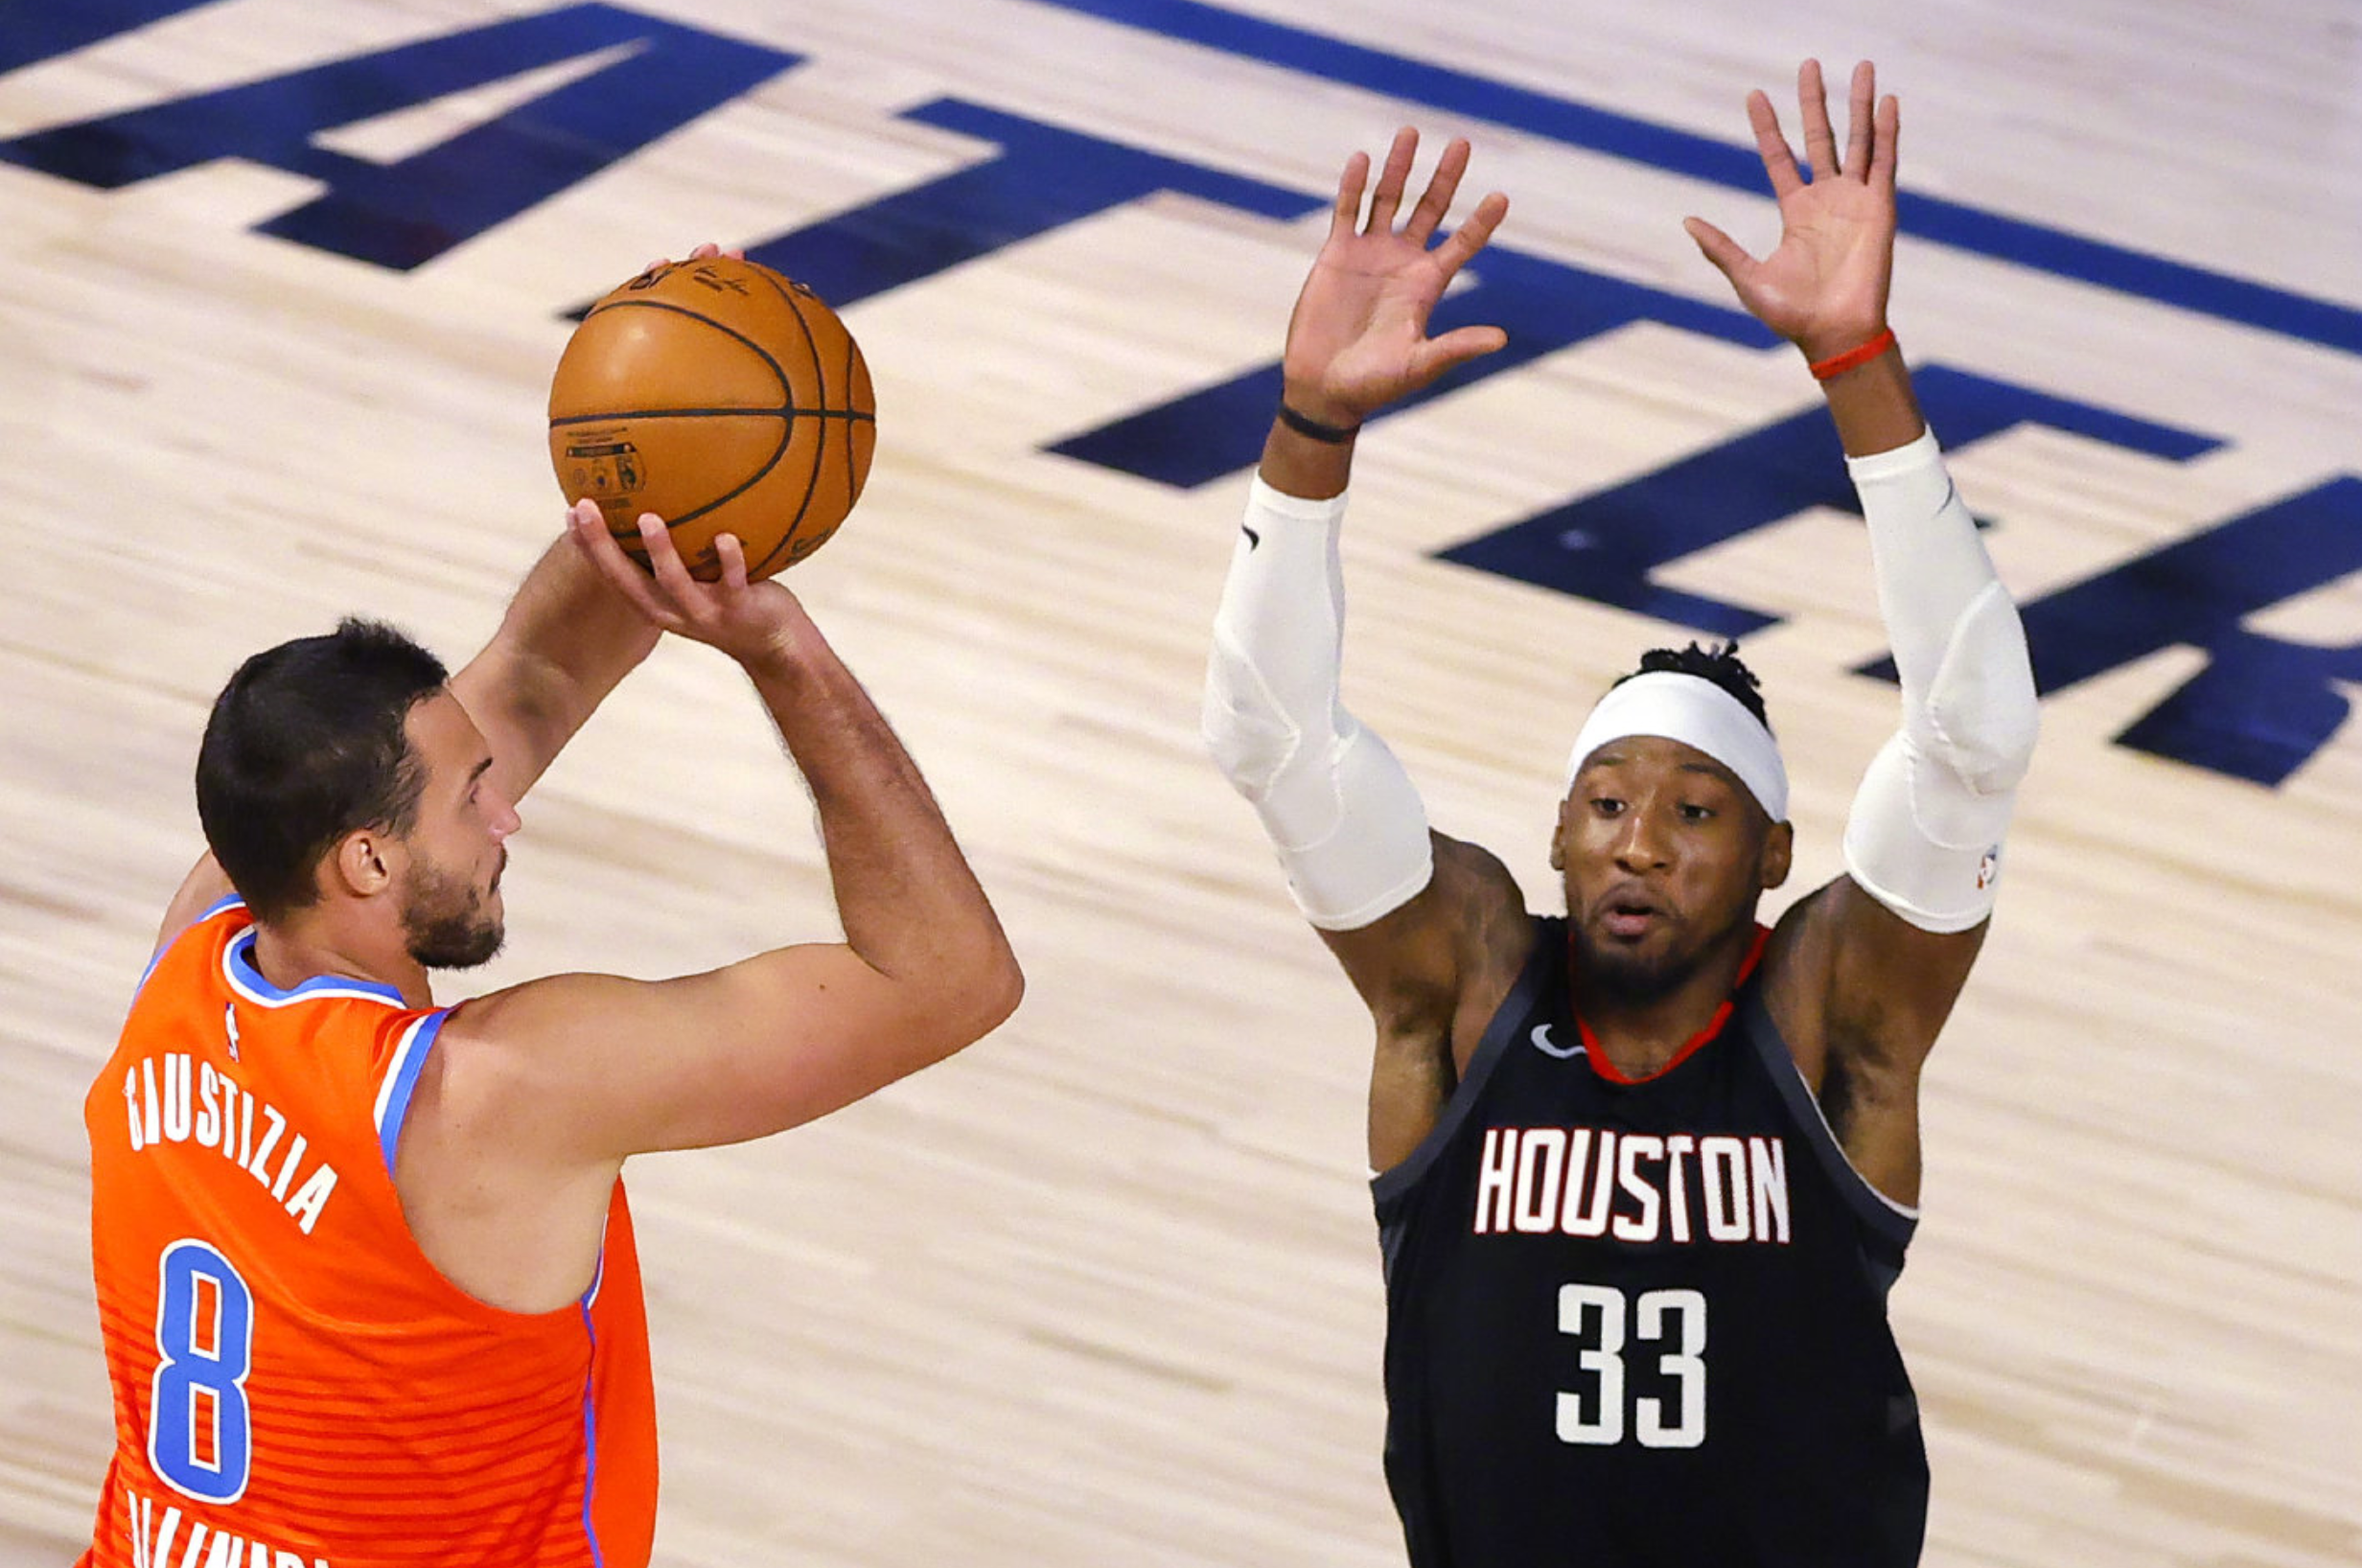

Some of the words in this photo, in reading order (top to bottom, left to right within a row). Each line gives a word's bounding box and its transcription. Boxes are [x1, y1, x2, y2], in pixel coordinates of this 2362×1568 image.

[0, 0, 2362, 790] ATTER
[122, 1052, 338, 1234] GIUSTIZIA
[1473, 1126, 1791, 1243] HOUSTON
[148, 1238, 254, 1505] 8
[1556, 1283, 1707, 1449] 33
